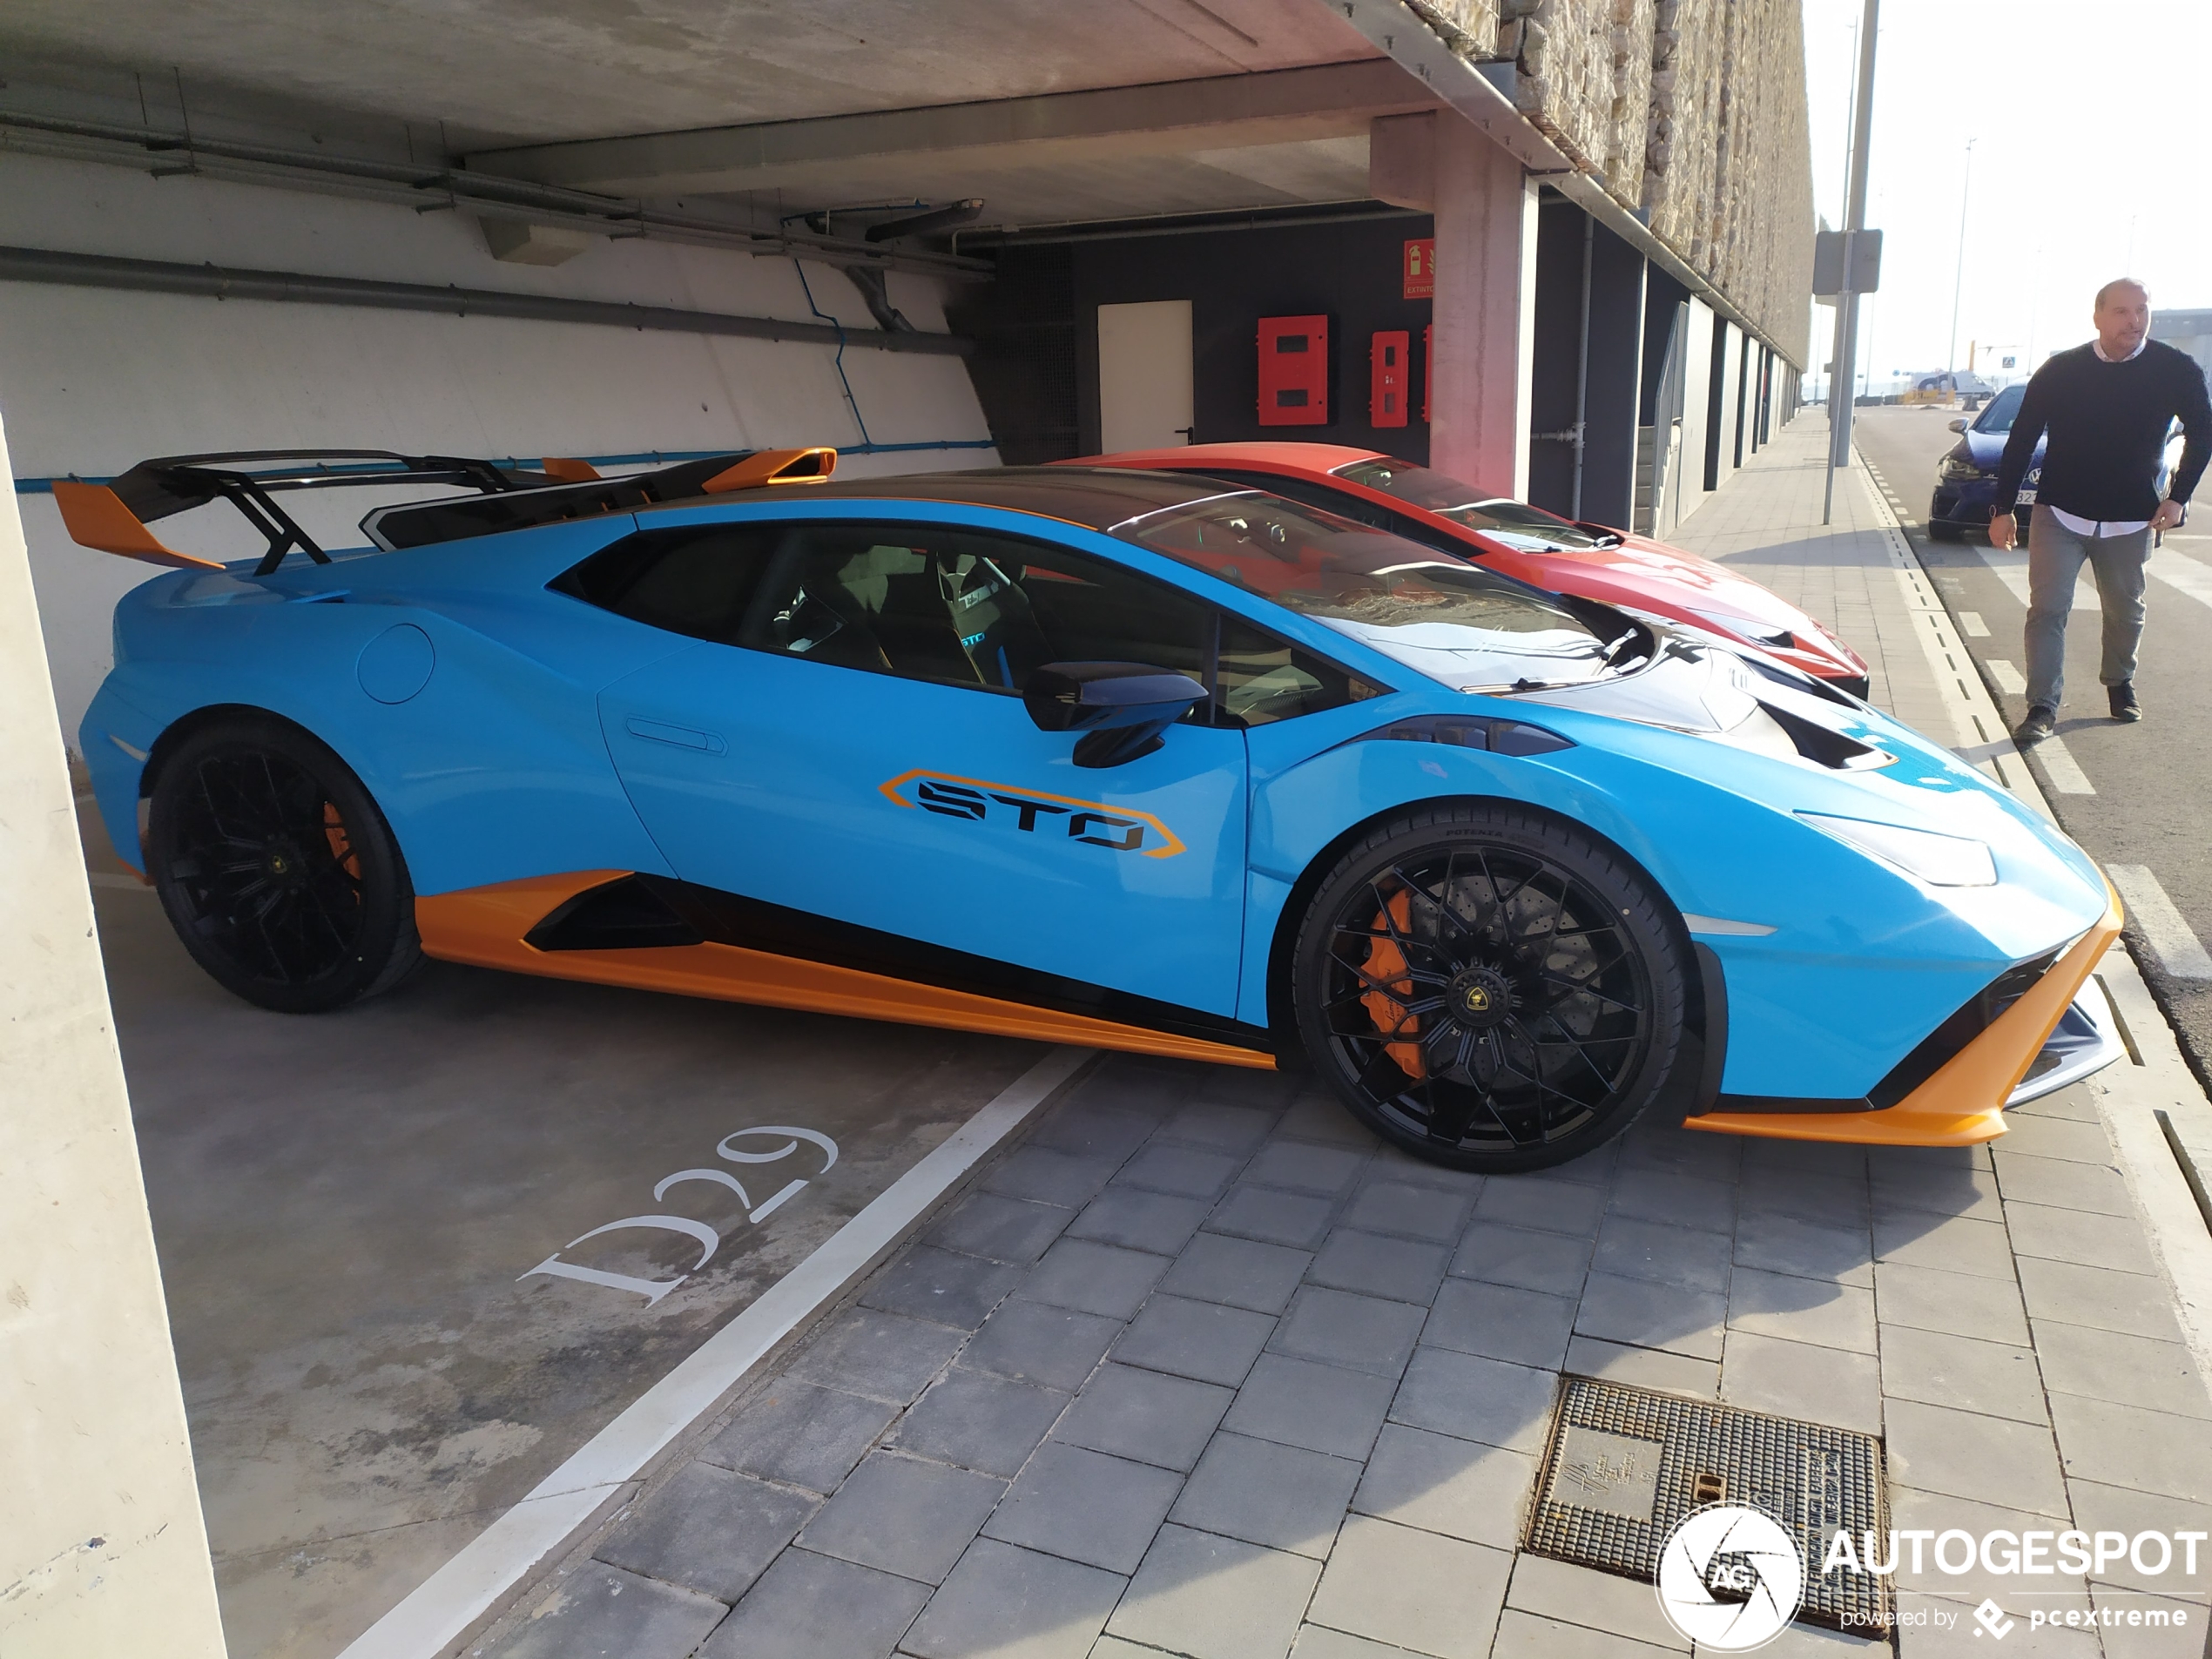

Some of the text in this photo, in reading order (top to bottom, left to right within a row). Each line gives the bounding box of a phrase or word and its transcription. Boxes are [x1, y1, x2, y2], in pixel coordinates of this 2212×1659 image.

[917, 780, 1144, 851] STO
[1447, 828, 1502, 838] POTENZA
[515, 1125, 839, 1309] D29
